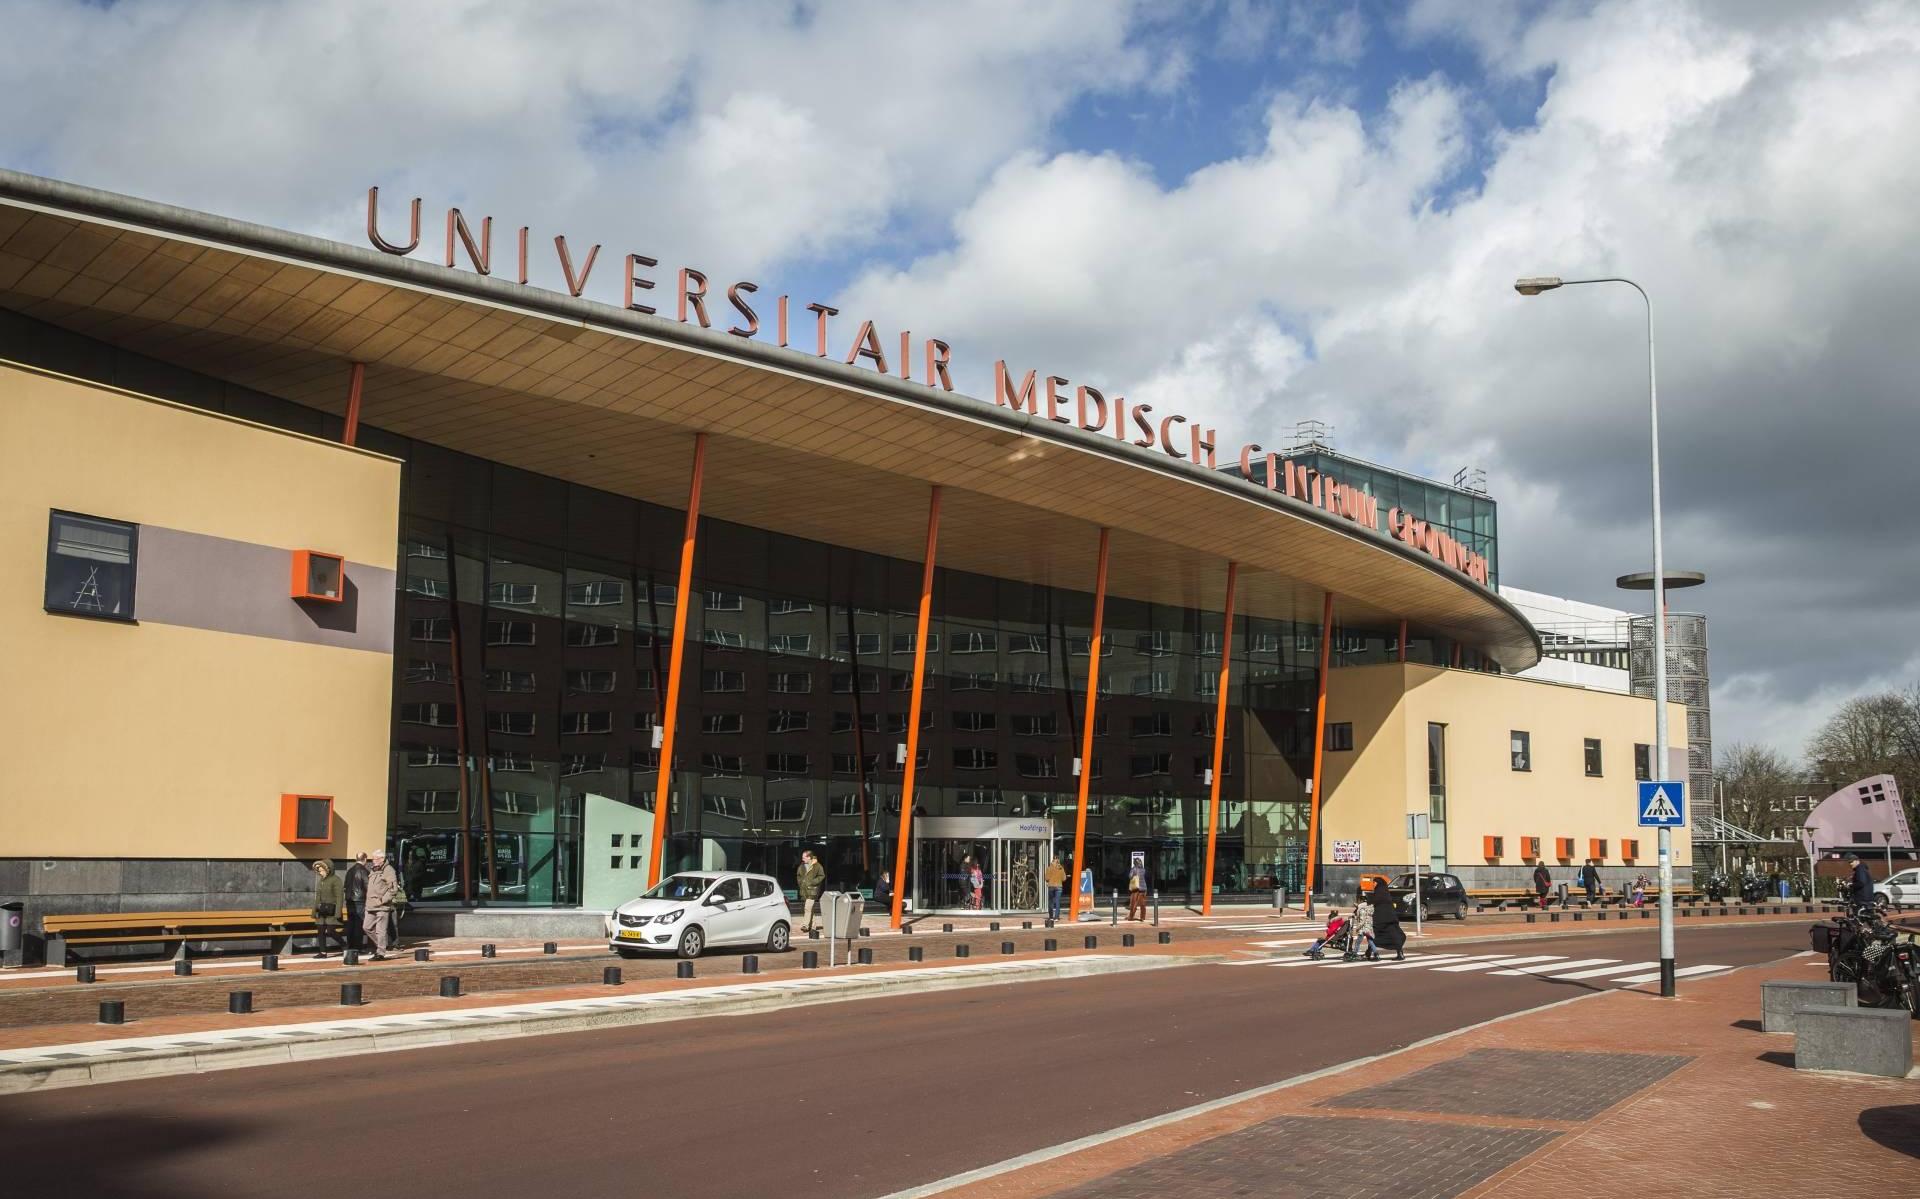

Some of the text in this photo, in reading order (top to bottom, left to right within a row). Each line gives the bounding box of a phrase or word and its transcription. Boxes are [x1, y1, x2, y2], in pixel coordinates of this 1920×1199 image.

[367, 186, 953, 391] UNIVERSITAIR
[995, 359, 1217, 469] MEDISCH
[1240, 444, 1379, 530] CENTRUM
